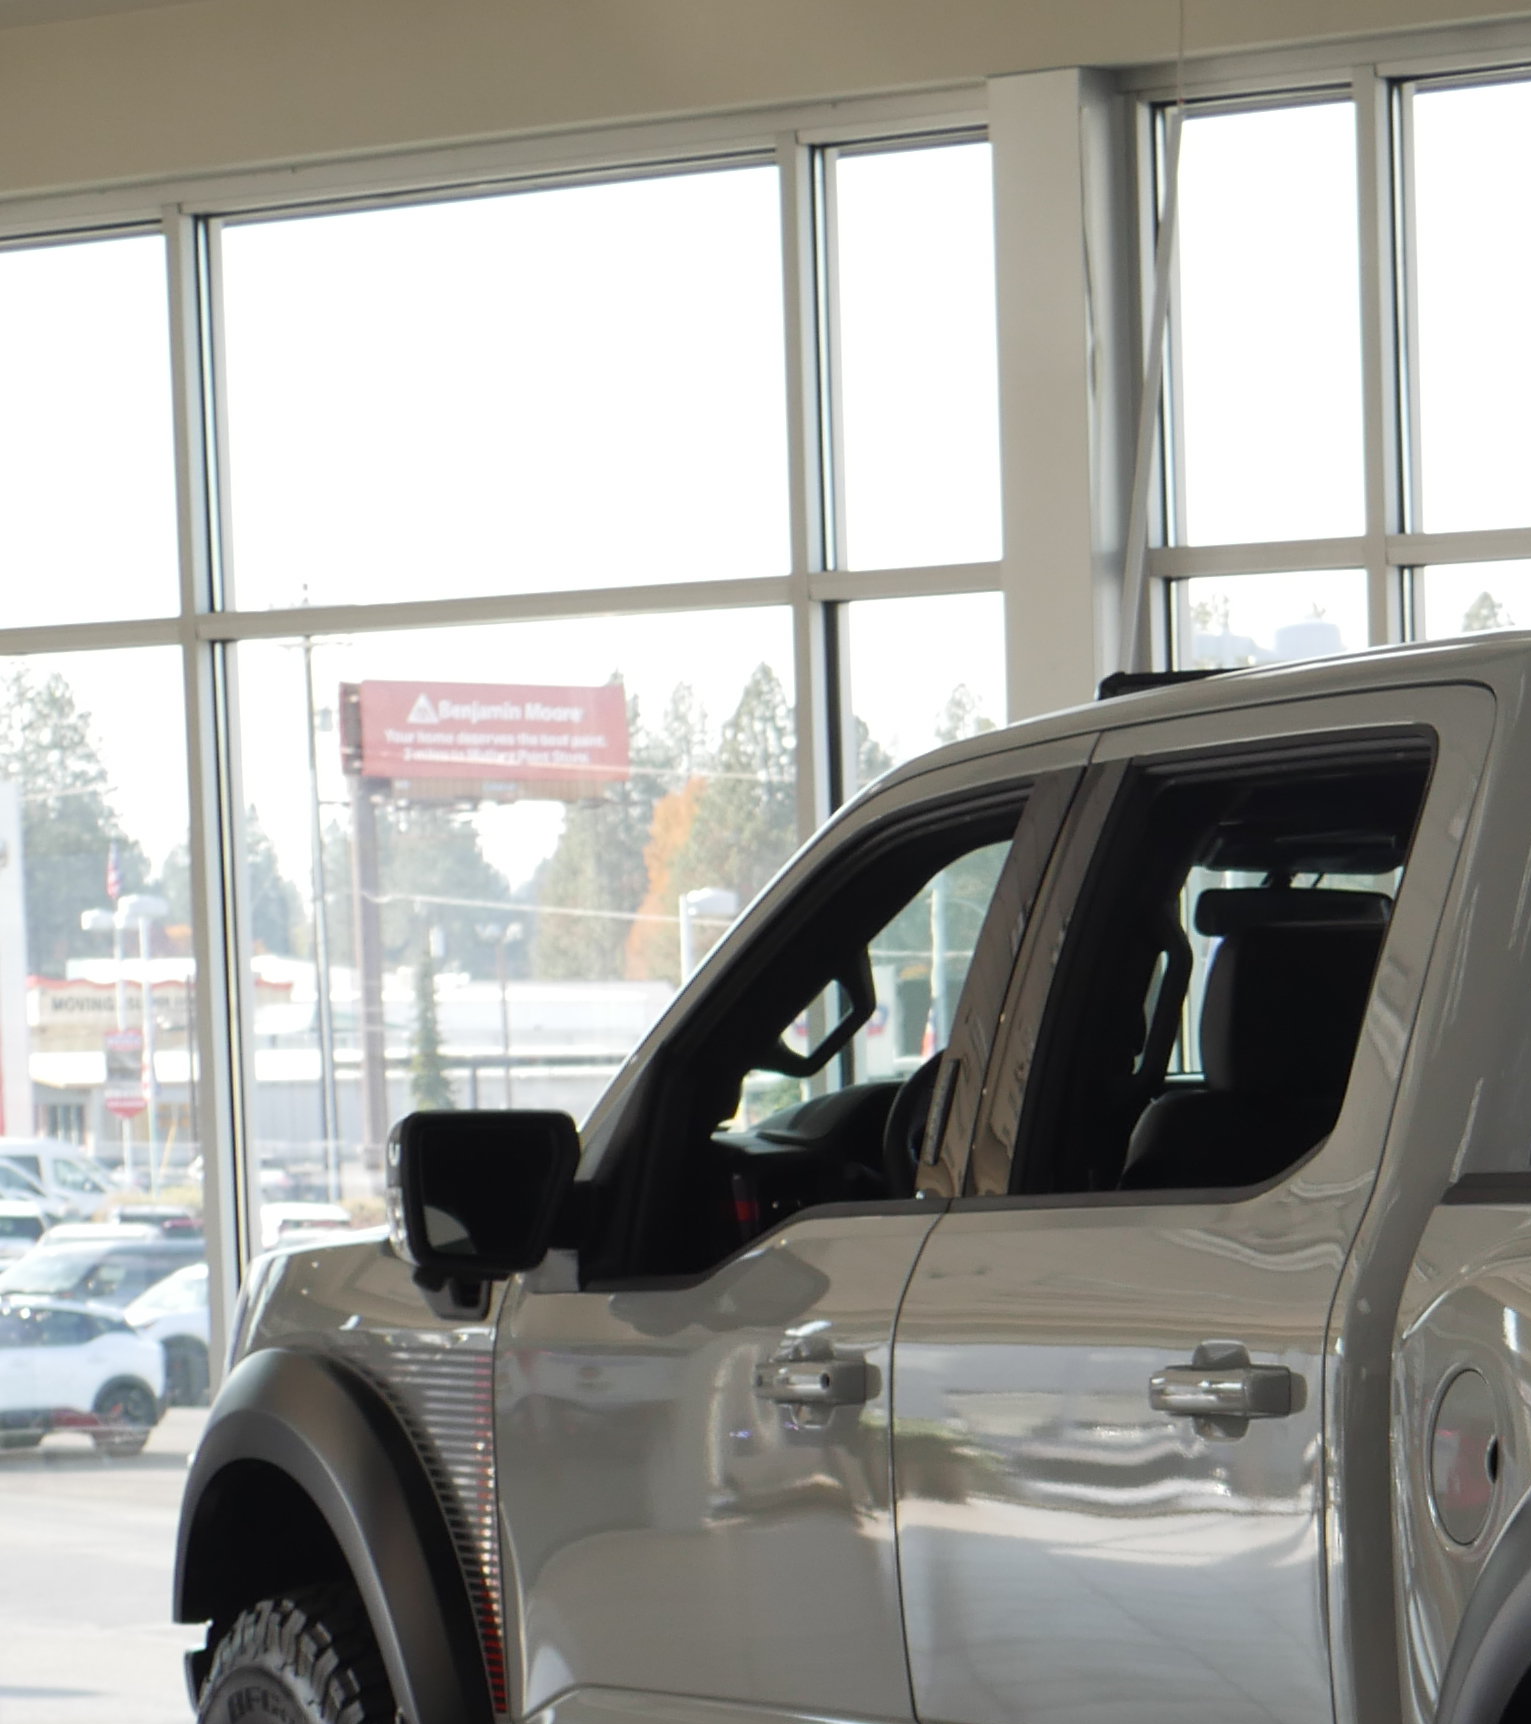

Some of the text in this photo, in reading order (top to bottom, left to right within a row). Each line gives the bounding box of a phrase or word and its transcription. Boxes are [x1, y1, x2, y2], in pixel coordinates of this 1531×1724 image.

[438, 699, 583, 724] Benjamin Moore
[385, 729, 415, 745] Your
[416, 731, 454, 745] home
[456, 732, 515, 747] deserves
[517, 732, 538, 746] the
[540, 733, 569, 747] best
[52, 997, 115, 1012] MOVING
